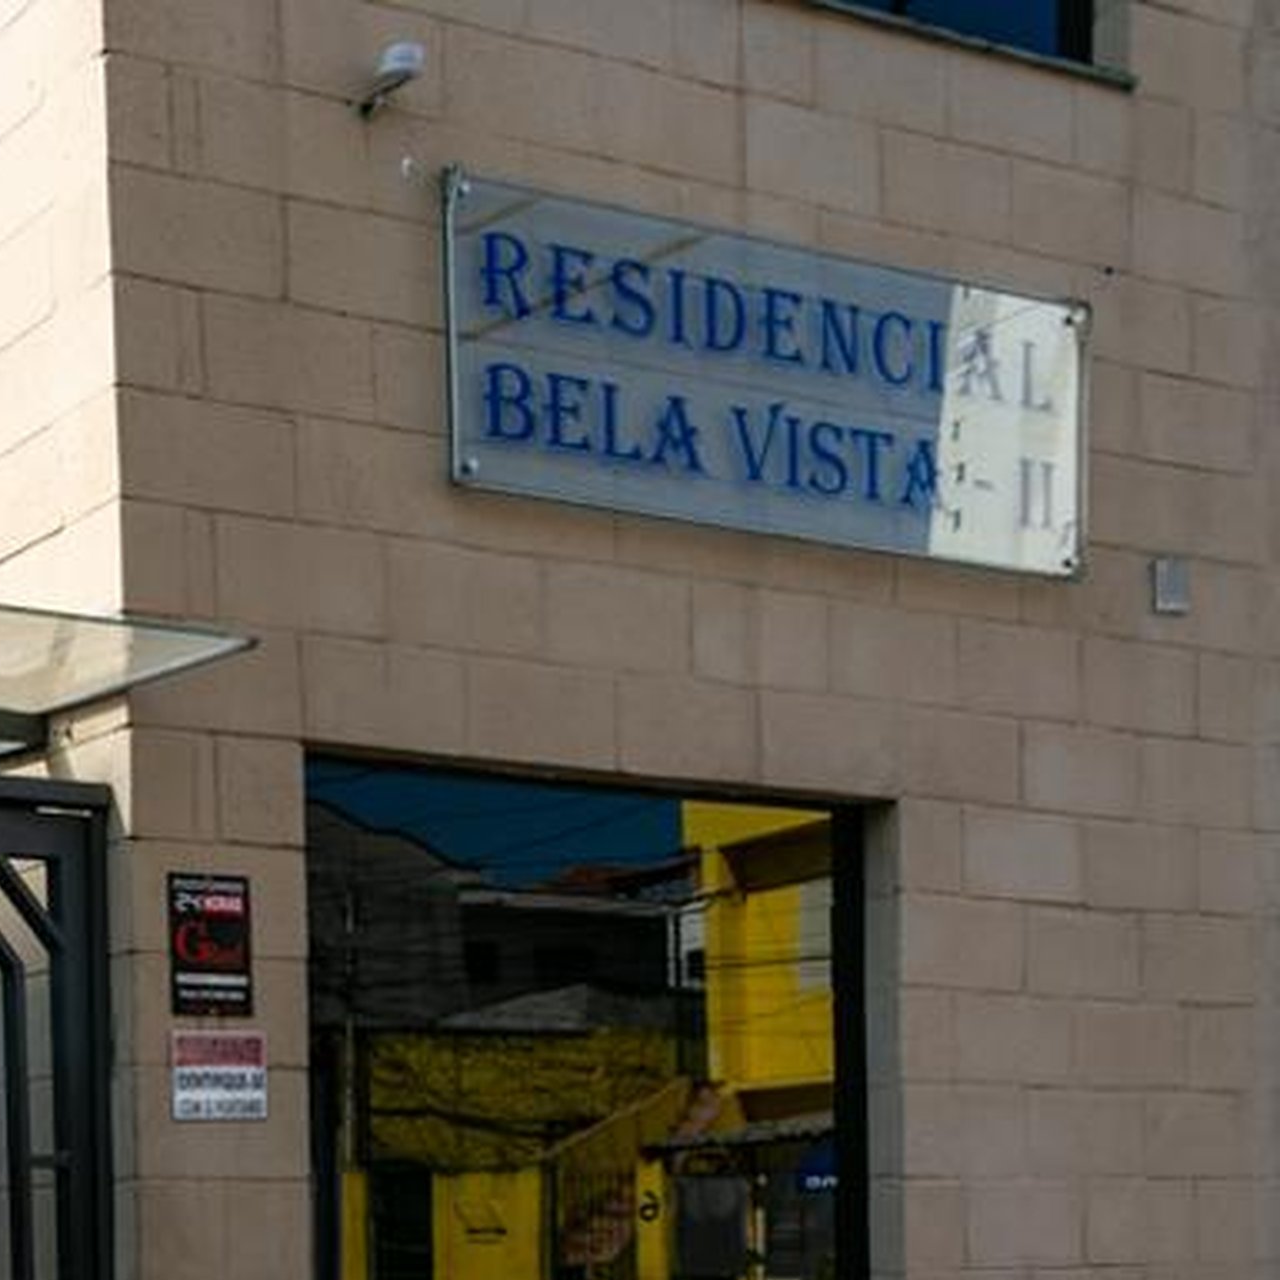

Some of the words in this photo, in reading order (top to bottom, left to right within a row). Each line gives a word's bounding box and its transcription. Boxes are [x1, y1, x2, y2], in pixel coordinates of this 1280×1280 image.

[479, 231, 1052, 413] RESIDENCIAL
[483, 362, 706, 479] BELA
[731, 402, 940, 509] VISTA
